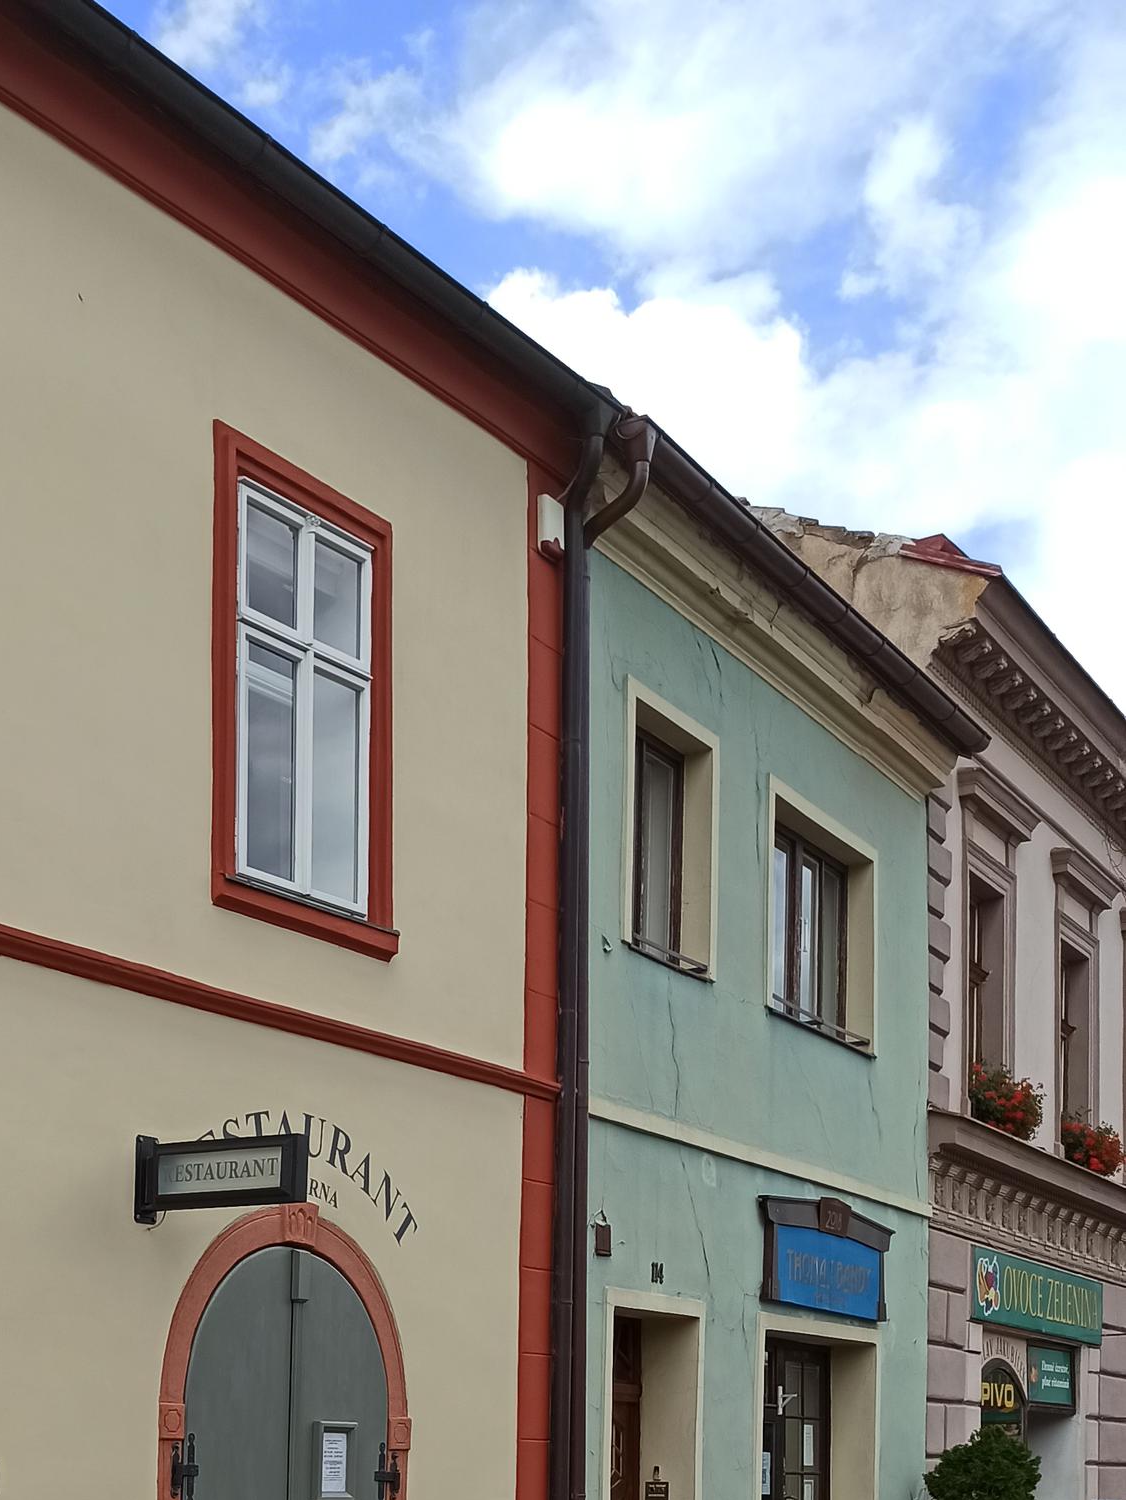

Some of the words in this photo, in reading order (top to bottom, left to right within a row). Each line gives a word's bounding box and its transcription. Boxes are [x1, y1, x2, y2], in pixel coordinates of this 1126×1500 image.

[650, 1261, 665, 1285] 114
[1003, 1265, 1044, 1318] OVOCE
[1045, 1278, 1100, 1330] ZELENINA
[981, 1381, 1015, 1408] PIVO
